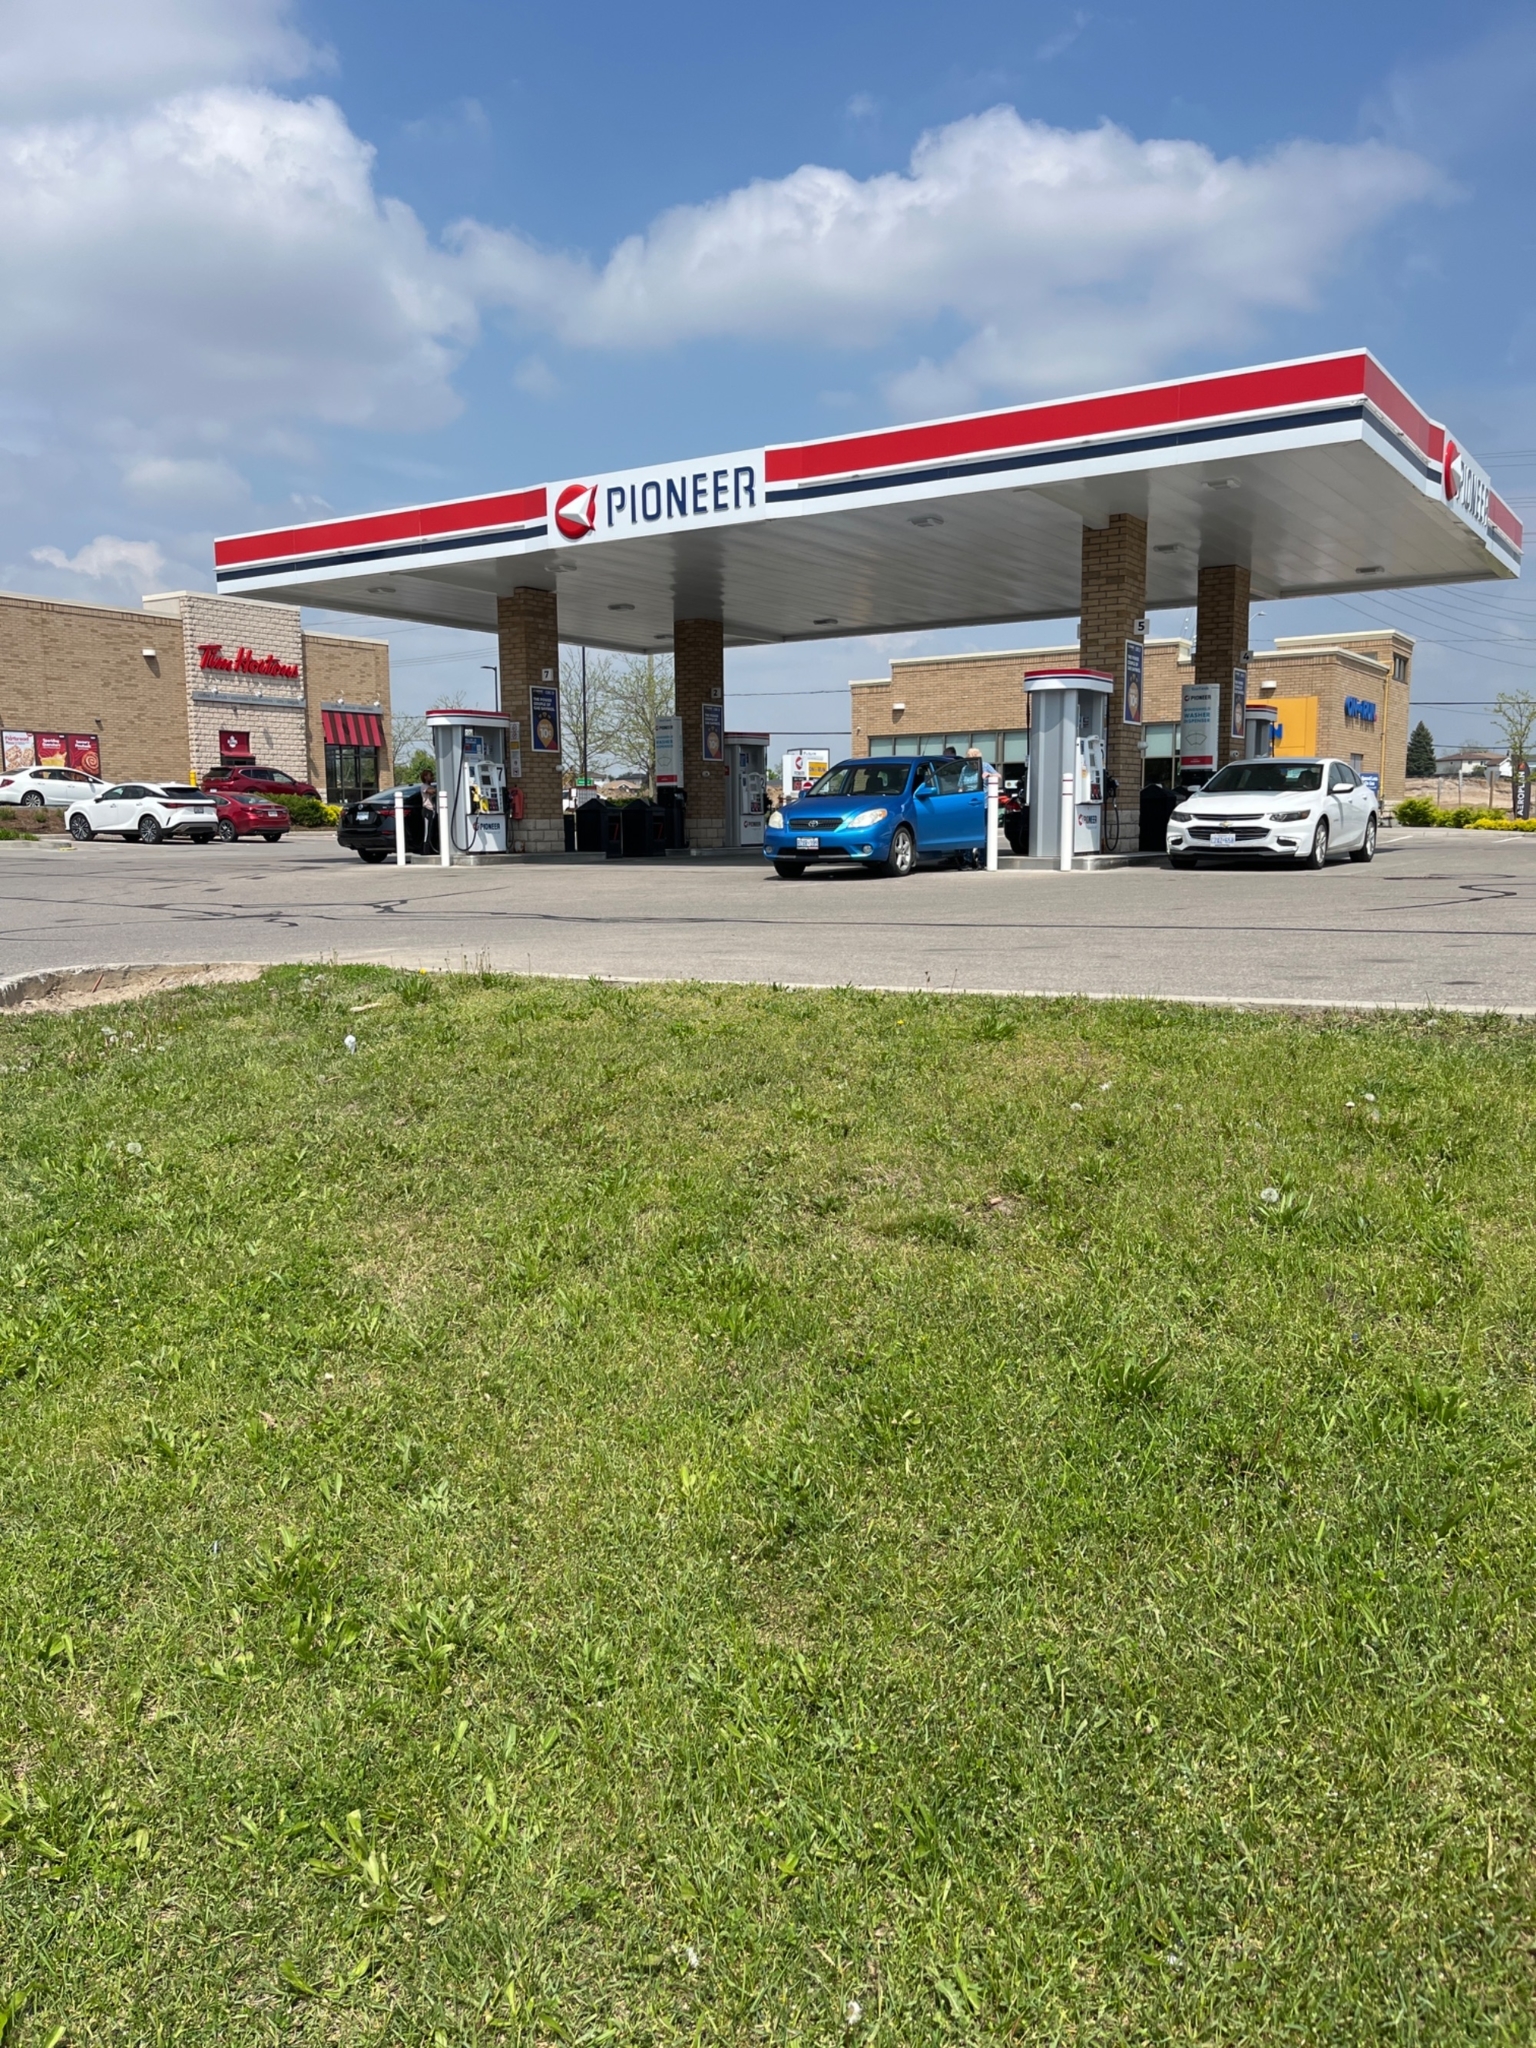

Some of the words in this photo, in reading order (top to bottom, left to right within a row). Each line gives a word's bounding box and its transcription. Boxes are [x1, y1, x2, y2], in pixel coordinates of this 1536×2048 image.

[607, 466, 755, 527] PIONEER
[1456, 460, 1489, 527] PIONEER
[1137, 621, 1145, 631] 5
[198, 644, 233, 672] Tim
[234, 646, 299, 679] Hortons
[1243, 652, 1250, 661] 4
[543, 670, 550, 679] 7
[496, 767, 503, 781] 7
[760, 777, 765, 789] 2
[1517, 771, 1525, 816] AEROPLAN
